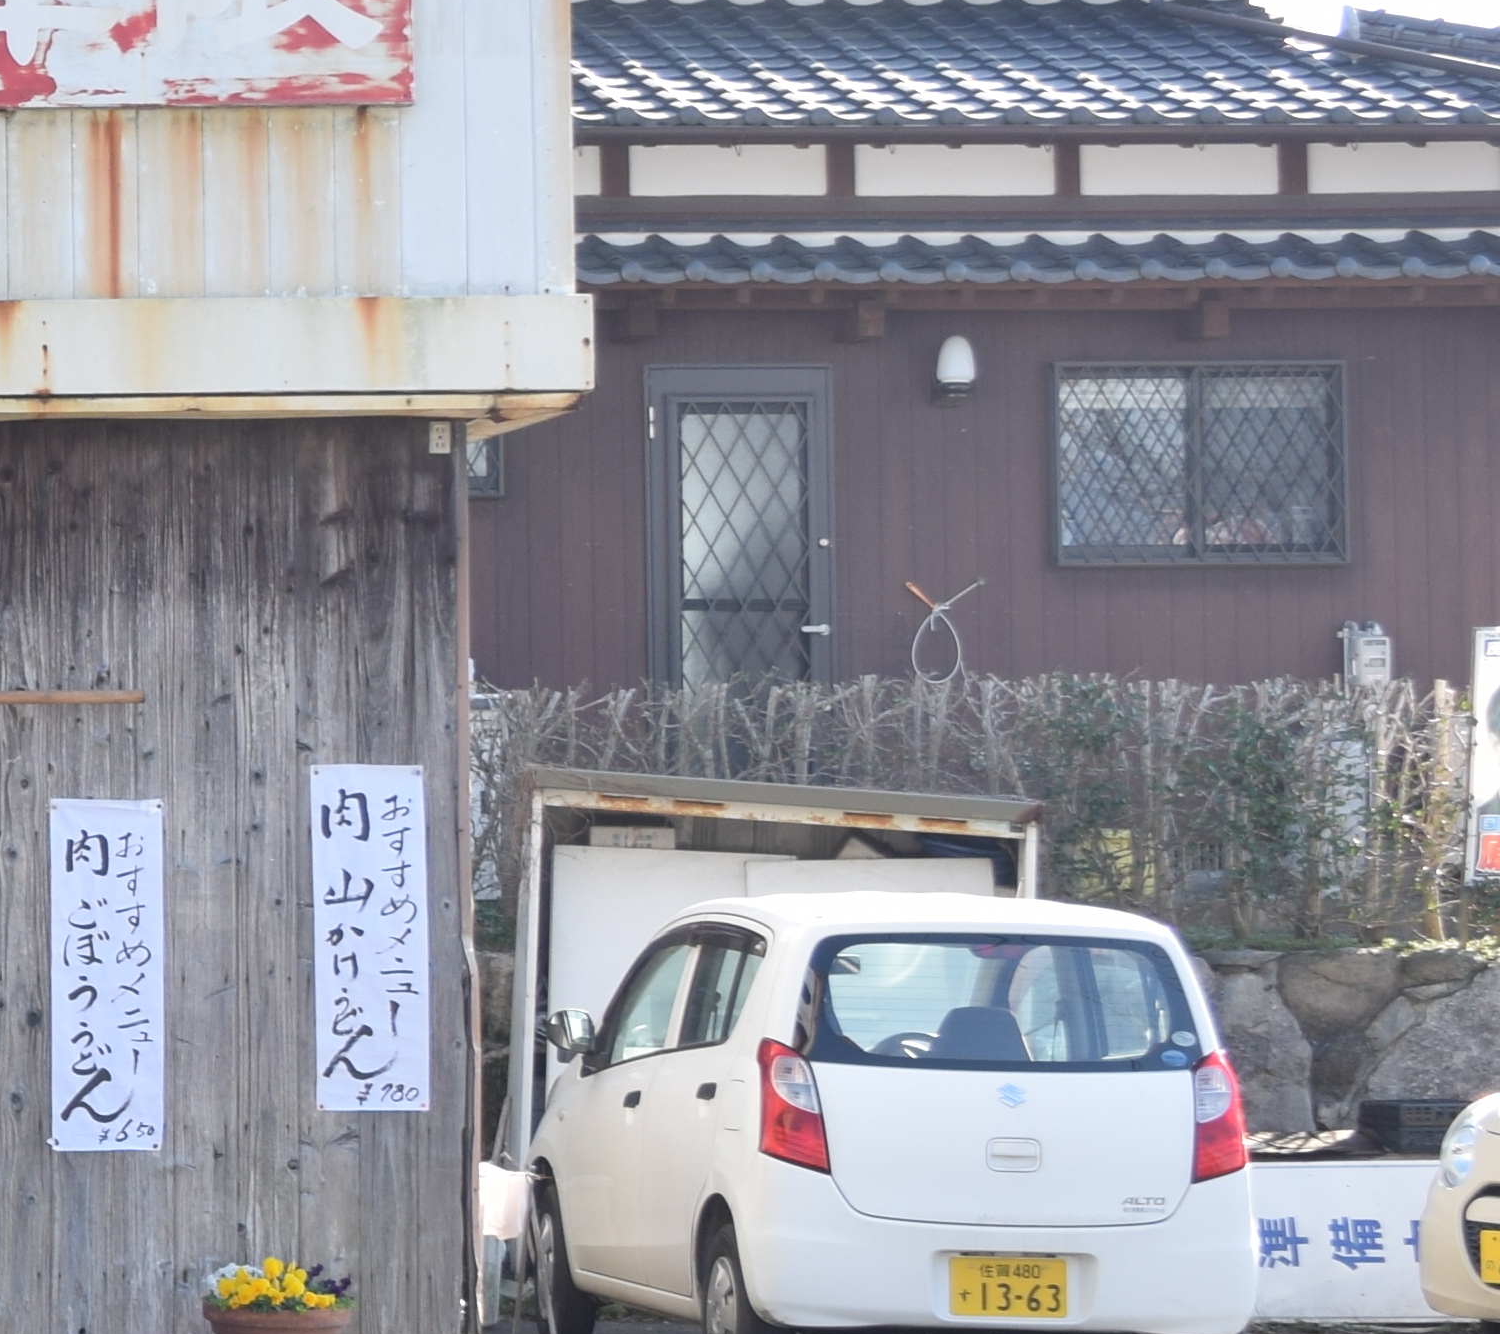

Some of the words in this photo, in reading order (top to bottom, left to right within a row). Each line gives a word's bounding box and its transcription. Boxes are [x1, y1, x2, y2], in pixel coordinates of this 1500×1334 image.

[111, 832, 155, 1075] おすすめメニュー
[373, 794, 420, 1037] おすすめメニュー
[1122, 1197, 1165, 1206] ALTO
[981, 1282, 1061, 1313] 13-63
